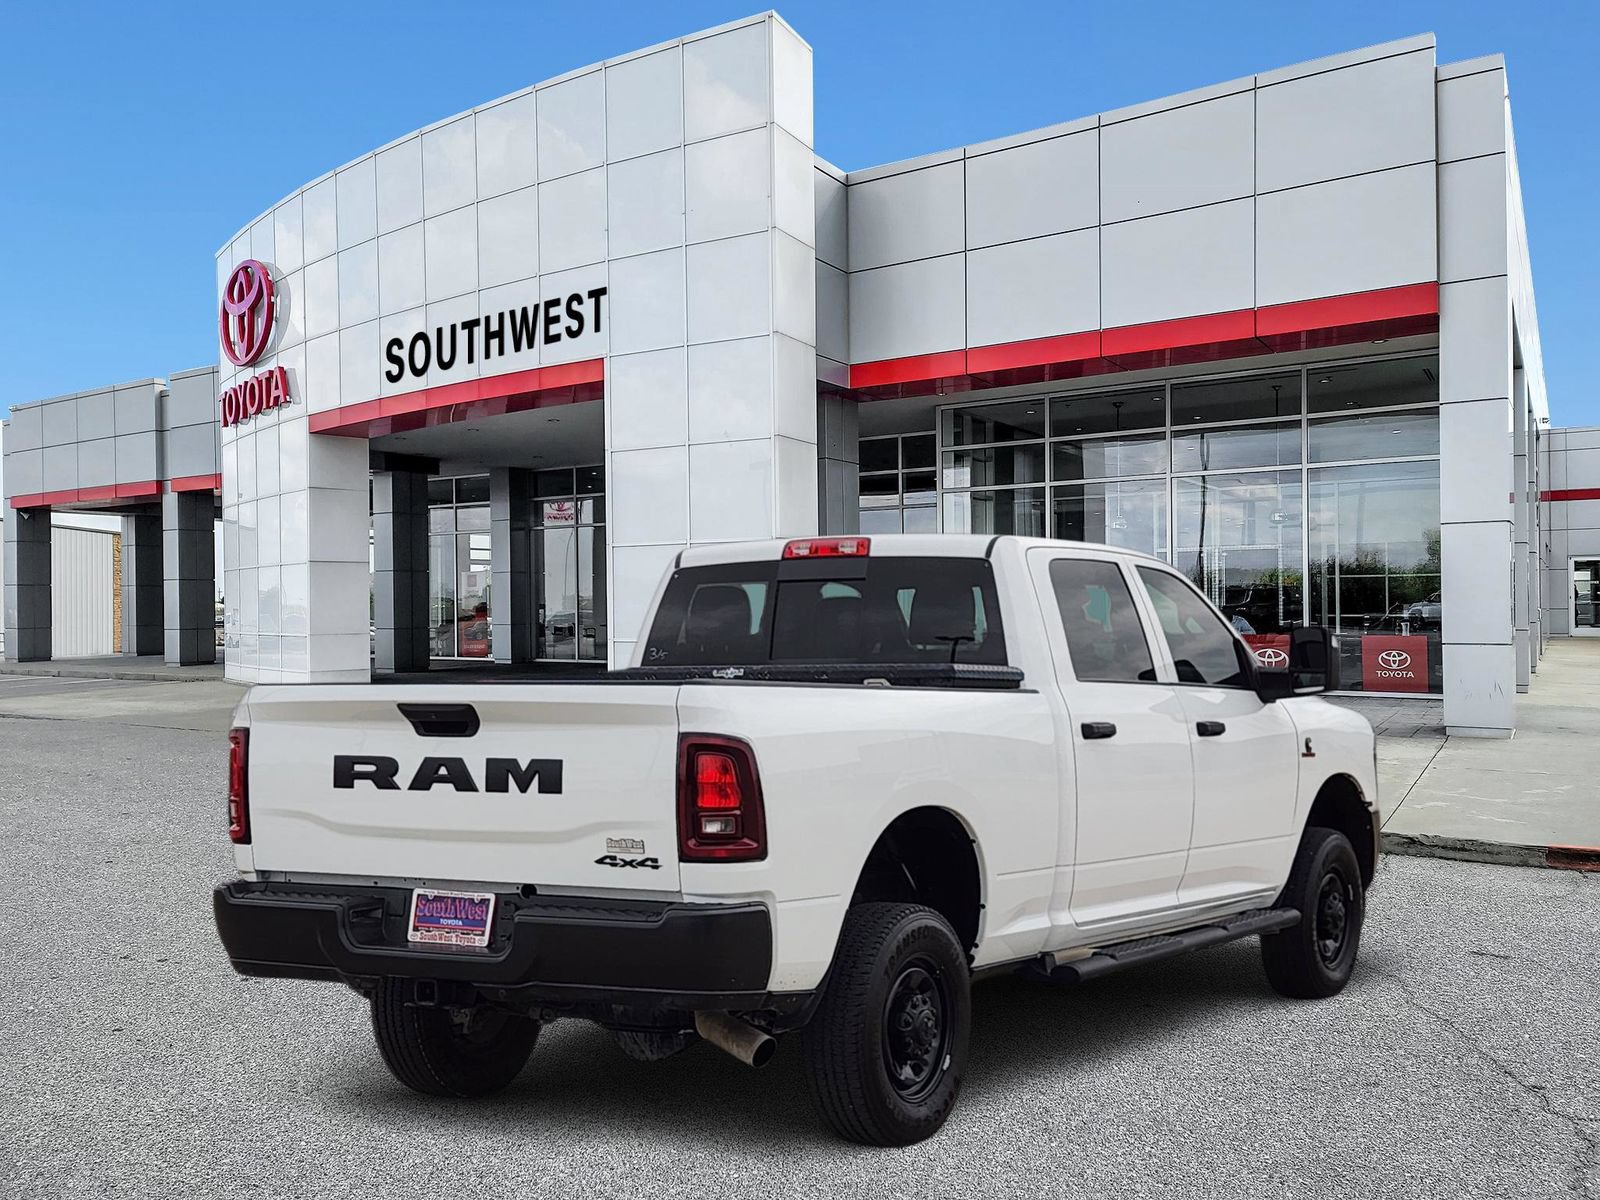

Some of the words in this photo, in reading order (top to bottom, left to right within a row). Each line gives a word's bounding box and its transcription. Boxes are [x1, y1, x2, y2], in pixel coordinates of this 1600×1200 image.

[385, 286, 607, 383] SOUTHWEST
[218, 366, 290, 427] TOYOTA
[1375, 670, 1415, 678] TOYOTA
[333, 755, 563, 795] RAM
[440, 918, 463, 926] TOYOTA
